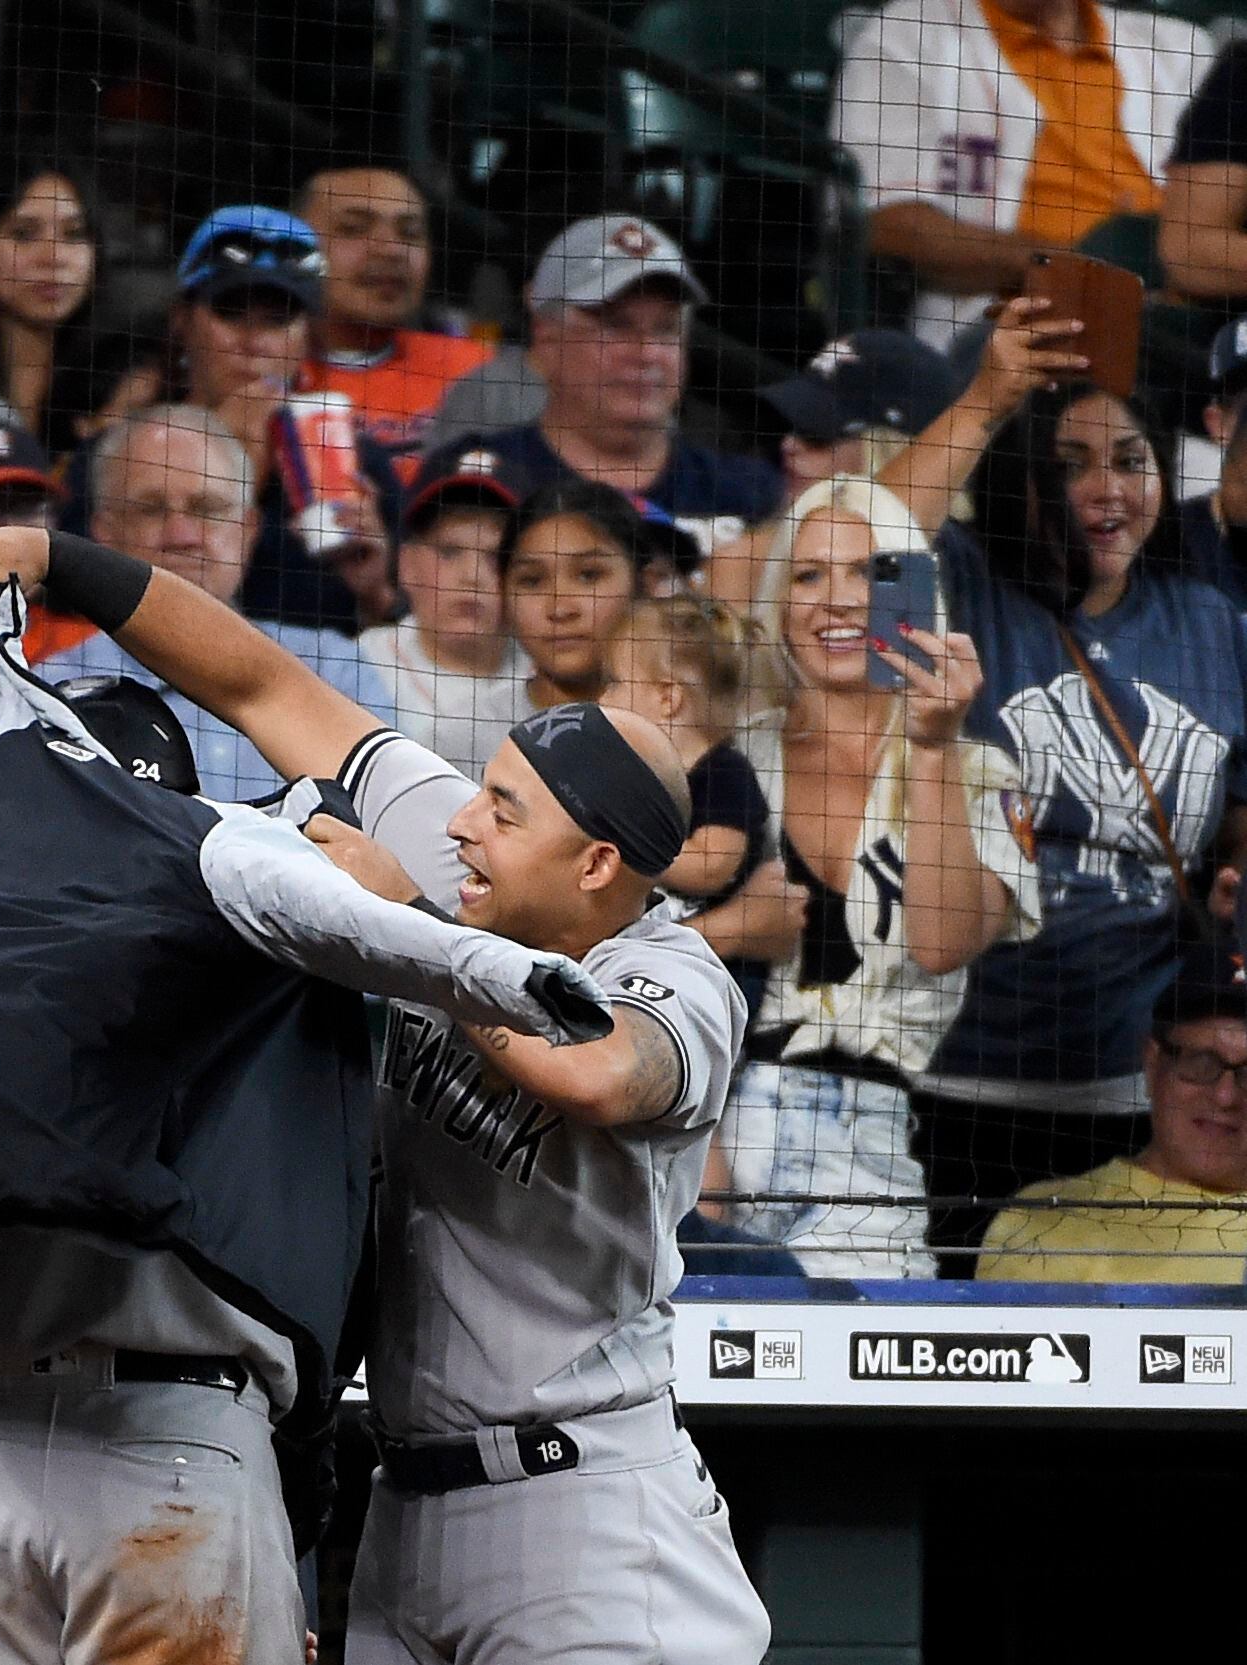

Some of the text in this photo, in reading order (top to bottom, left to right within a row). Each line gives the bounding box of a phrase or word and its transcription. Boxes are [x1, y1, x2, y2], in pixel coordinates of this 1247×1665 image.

[132, 758, 161, 782] 24
[628, 978, 667, 998] 16
[424, 1046, 565, 1189] YORK
[762, 1341, 796, 1355] NEW
[857, 1338, 1021, 1376] MLB.com
[1192, 1346, 1225, 1360] NEW
[762, 1355, 795, 1369] ERA
[1192, 1360, 1225, 1374] ERA
[536, 1440, 563, 1463] 18
